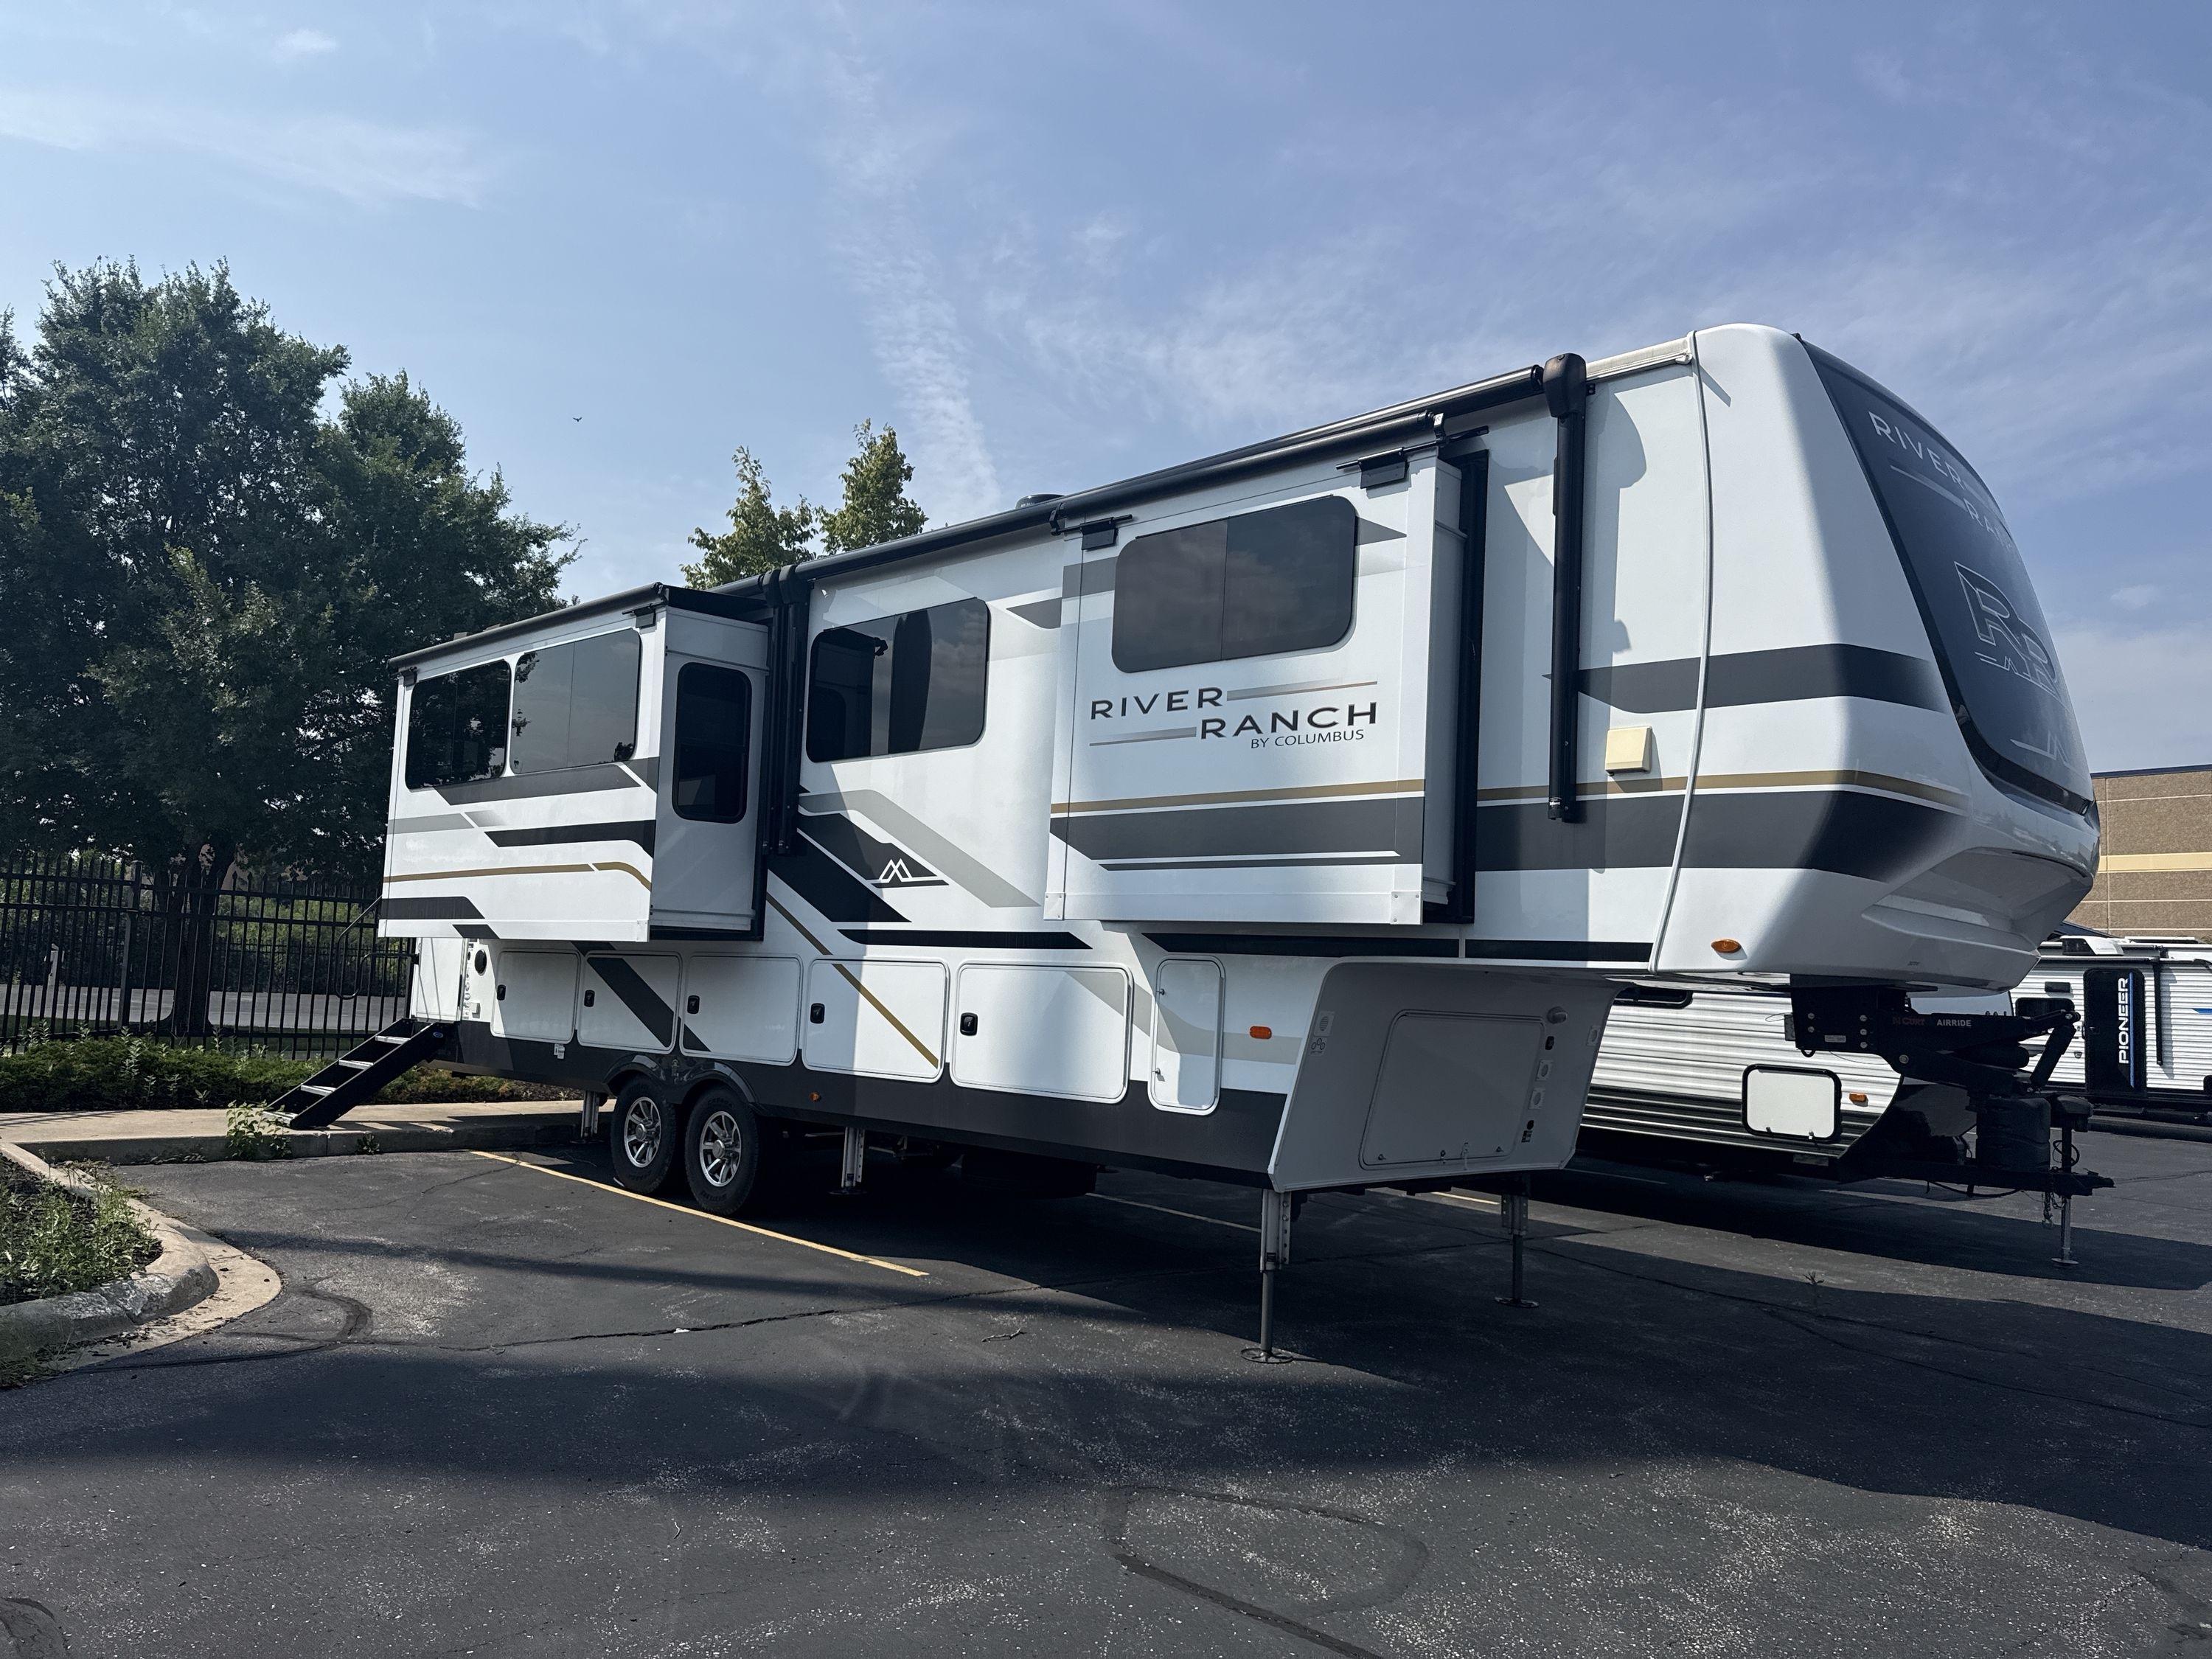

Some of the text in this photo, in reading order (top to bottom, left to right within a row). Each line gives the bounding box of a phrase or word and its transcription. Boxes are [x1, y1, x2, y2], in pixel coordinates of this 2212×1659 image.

[1868, 411, 1965, 490] RIVER
[1091, 686, 1223, 720] RIVER
[1200, 701, 1377, 740] RANCH
[1251, 729, 1365, 749] BY COLUMBUS
[1936, 1019, 1972, 1027] AIRRIDE
[2118, 978, 2129, 1064] PIONEER
